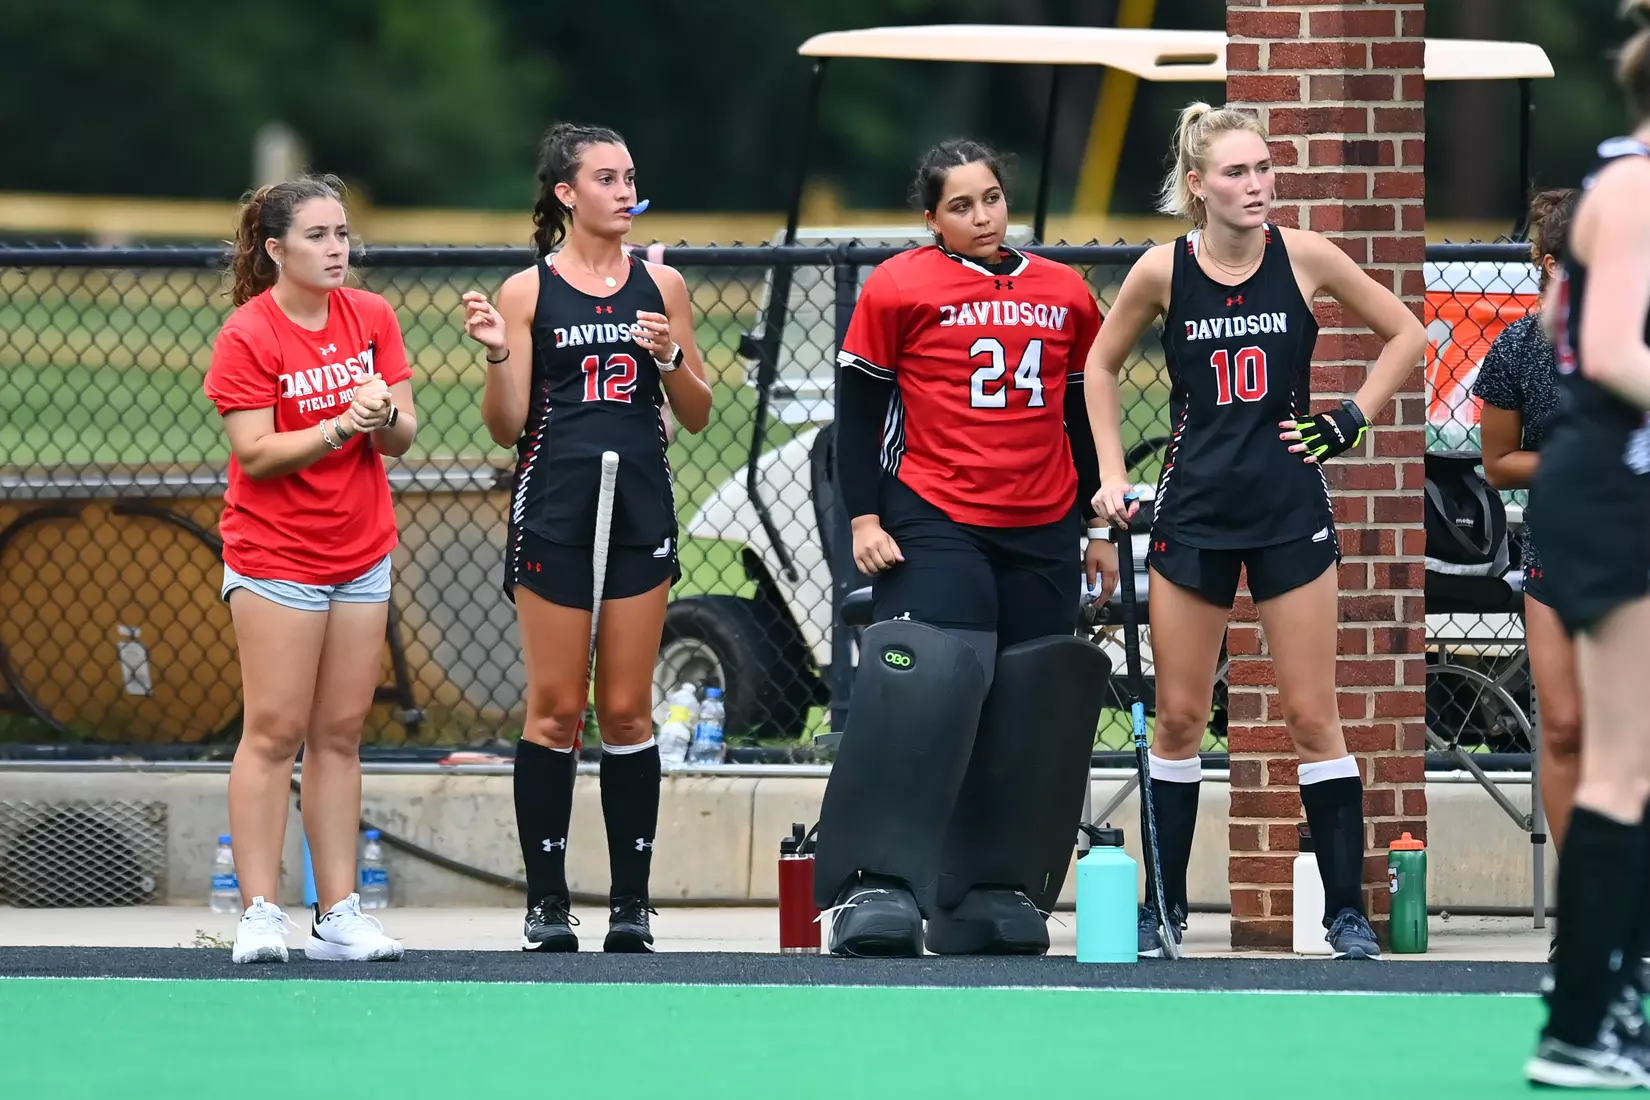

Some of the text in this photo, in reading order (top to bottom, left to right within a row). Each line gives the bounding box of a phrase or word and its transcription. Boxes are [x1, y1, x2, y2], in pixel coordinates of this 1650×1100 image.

[938, 300, 1069, 331] DAVIDSON
[1184, 312, 1288, 341] DAVIDSON
[581, 353, 638, 404] 12
[969, 336, 1046, 409] 24
[1210, 345, 1269, 406] 10
[298, 393, 336, 414] FIELD
[885, 652, 910, 667] OBO
